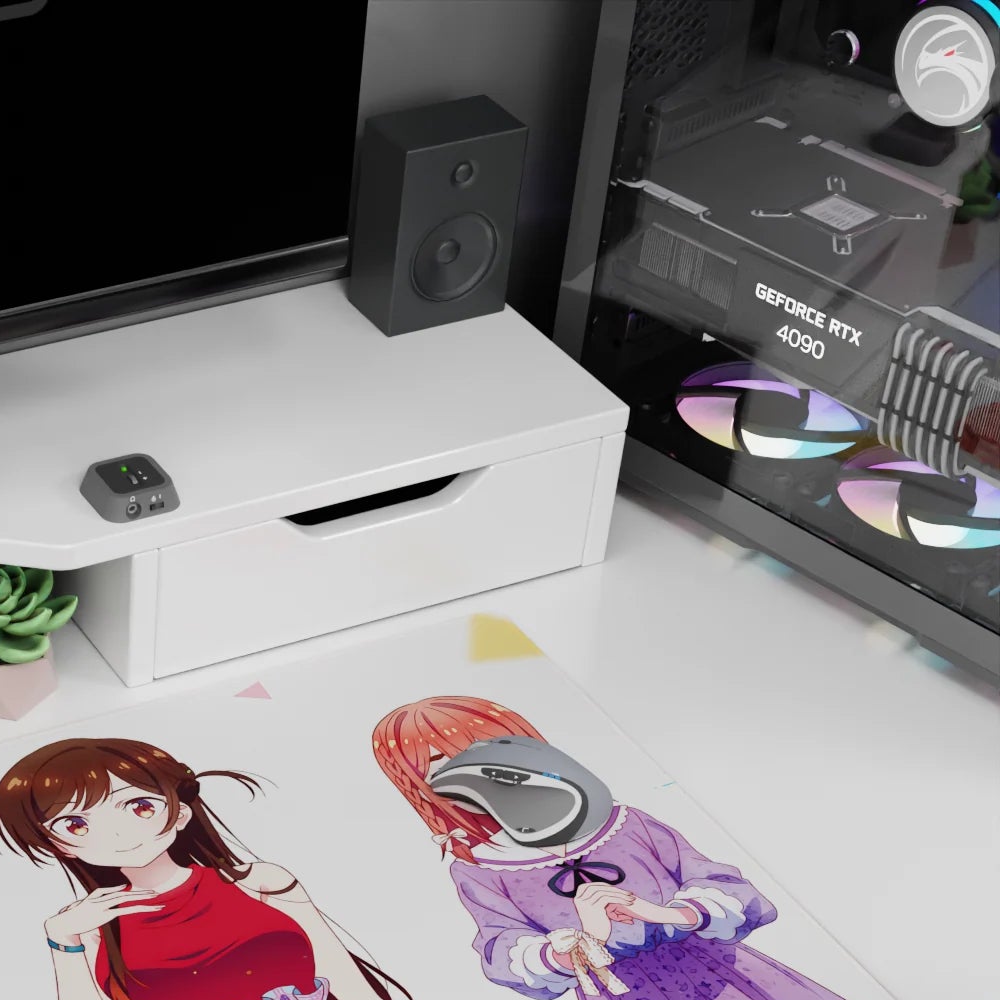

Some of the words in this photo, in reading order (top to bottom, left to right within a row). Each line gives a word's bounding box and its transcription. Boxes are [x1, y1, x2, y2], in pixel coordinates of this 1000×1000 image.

[755, 282, 827, 329] GEFORCE
[828, 318, 863, 346] RTX
[776, 325, 825, 360] 4090
